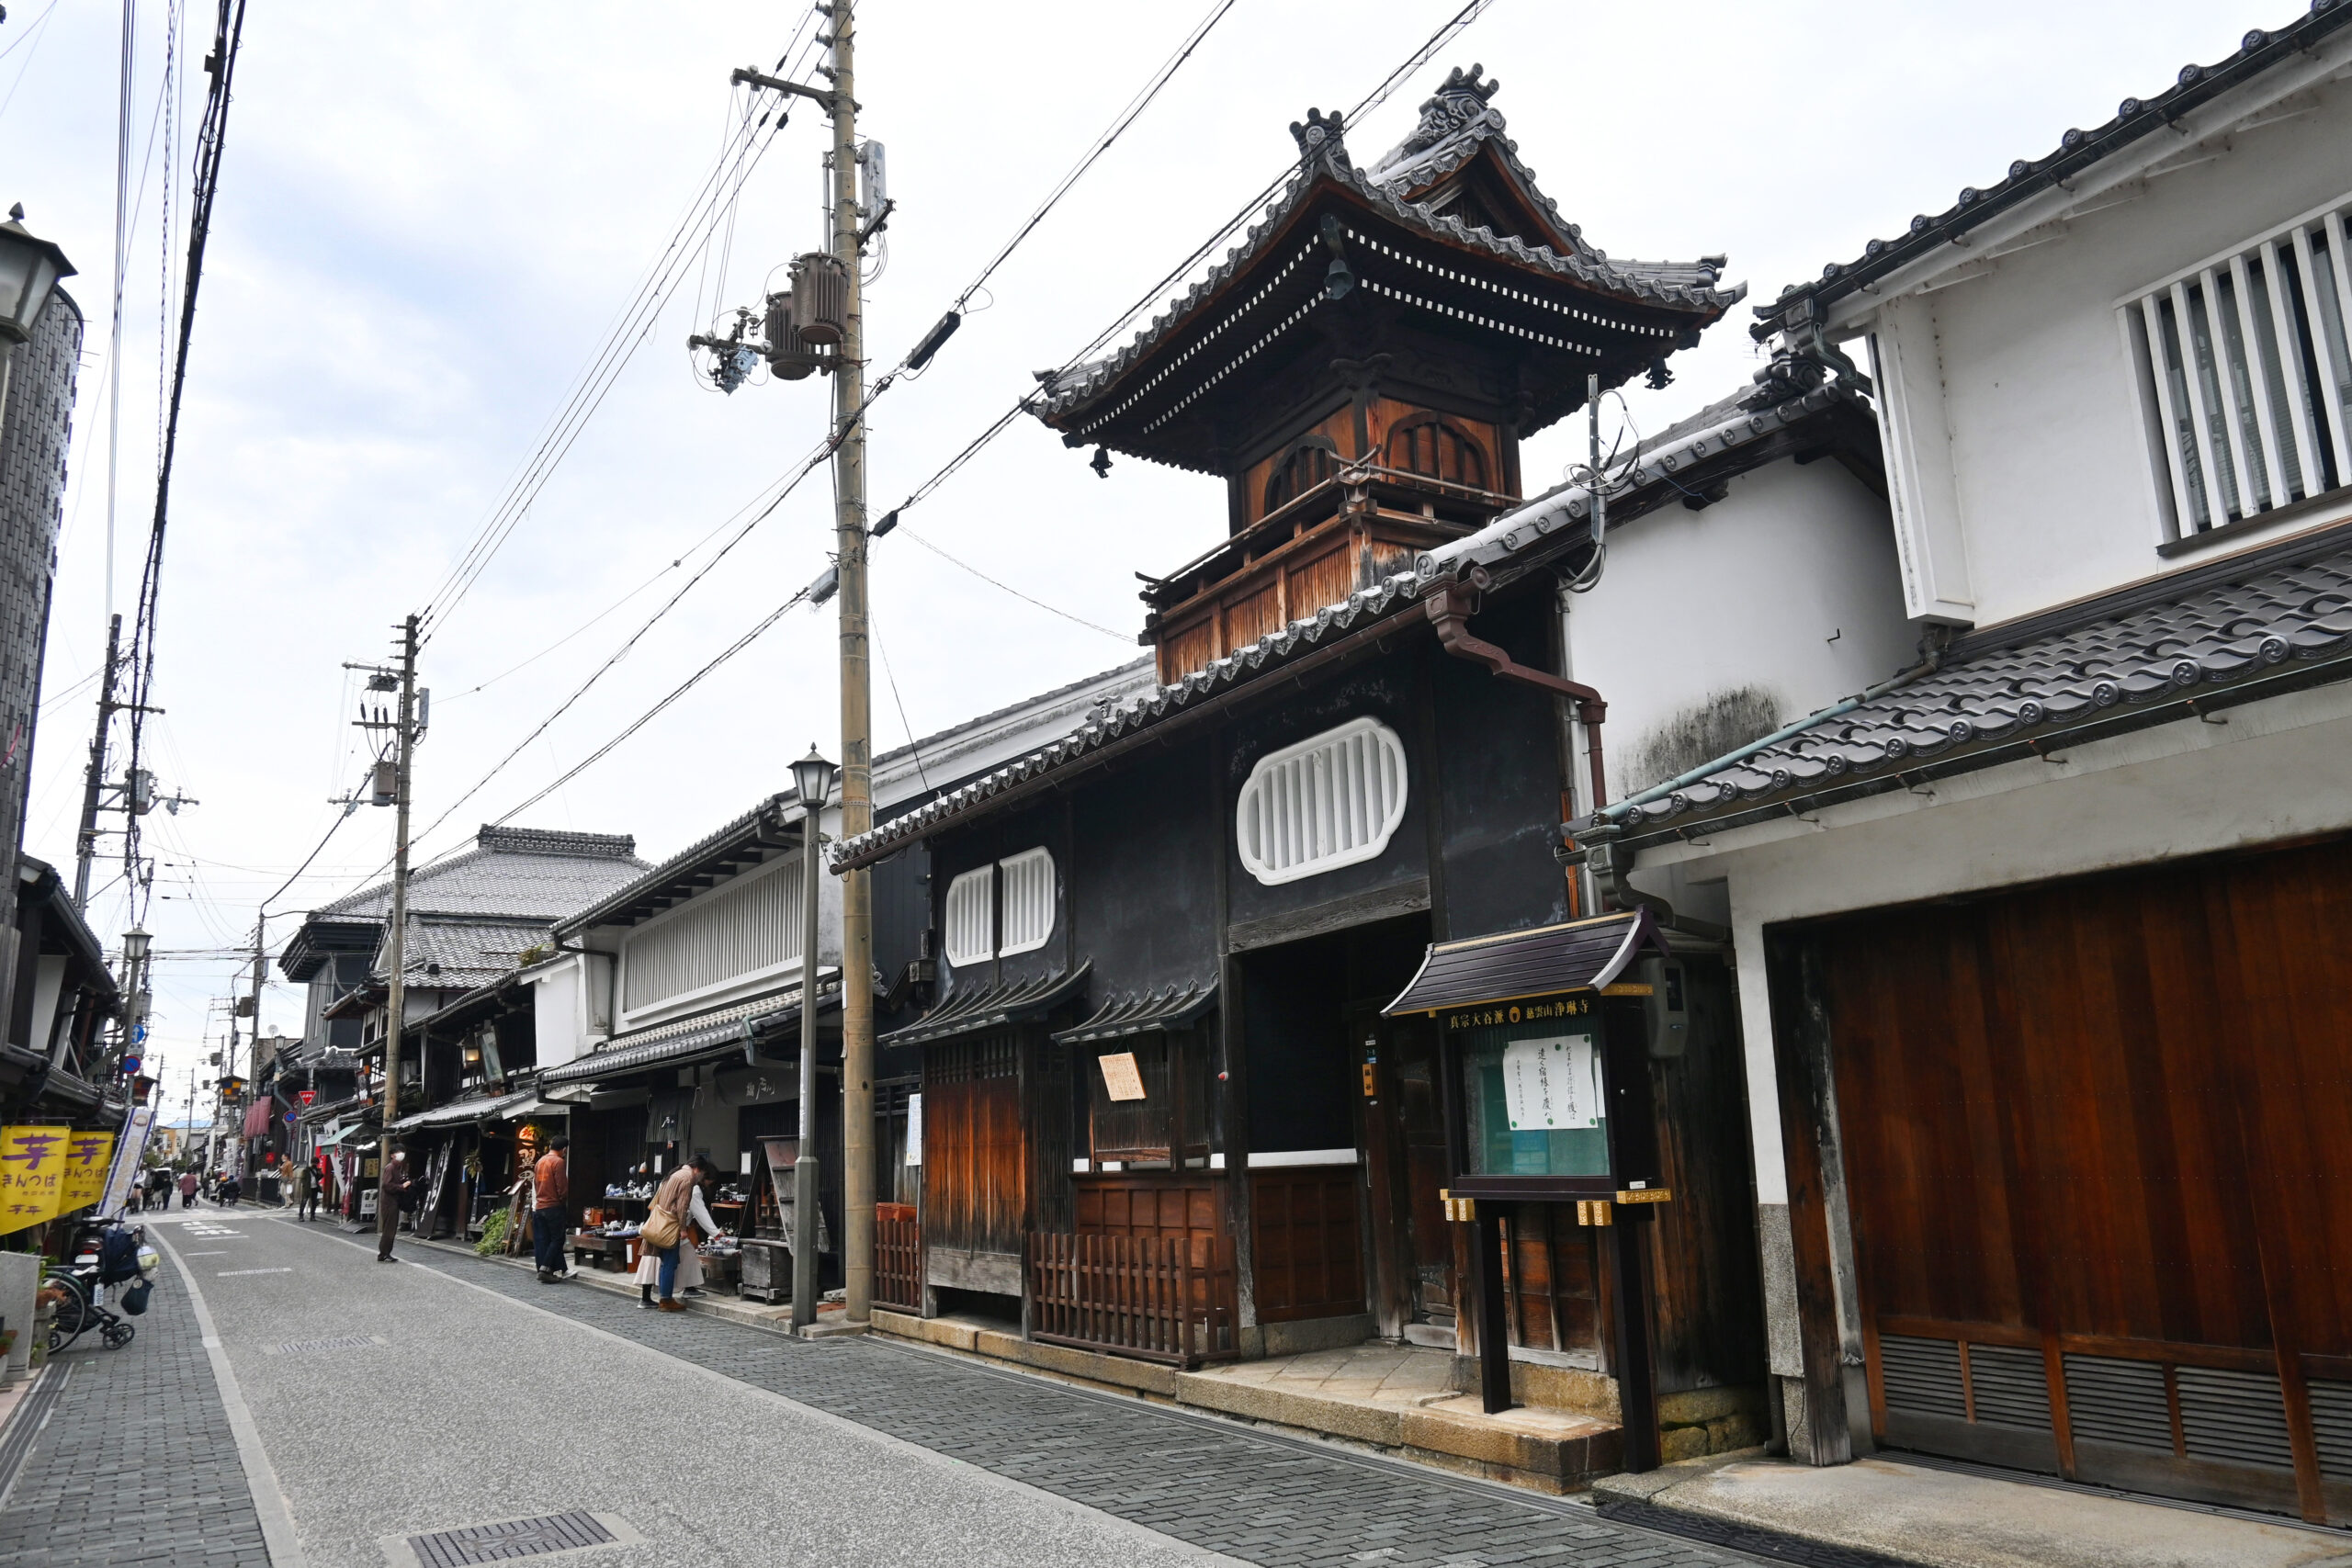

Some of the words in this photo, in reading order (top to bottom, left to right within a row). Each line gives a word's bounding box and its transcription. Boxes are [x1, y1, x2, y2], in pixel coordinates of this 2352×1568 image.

[1450, 1010, 1505, 1029] 真宗大谷派
[2, 1133, 66, 1170] 芋
[66, 1137, 109, 1165] 芋
[2, 1174, 57, 1188] きんつば
[63, 1168, 105, 1179] きんつば
